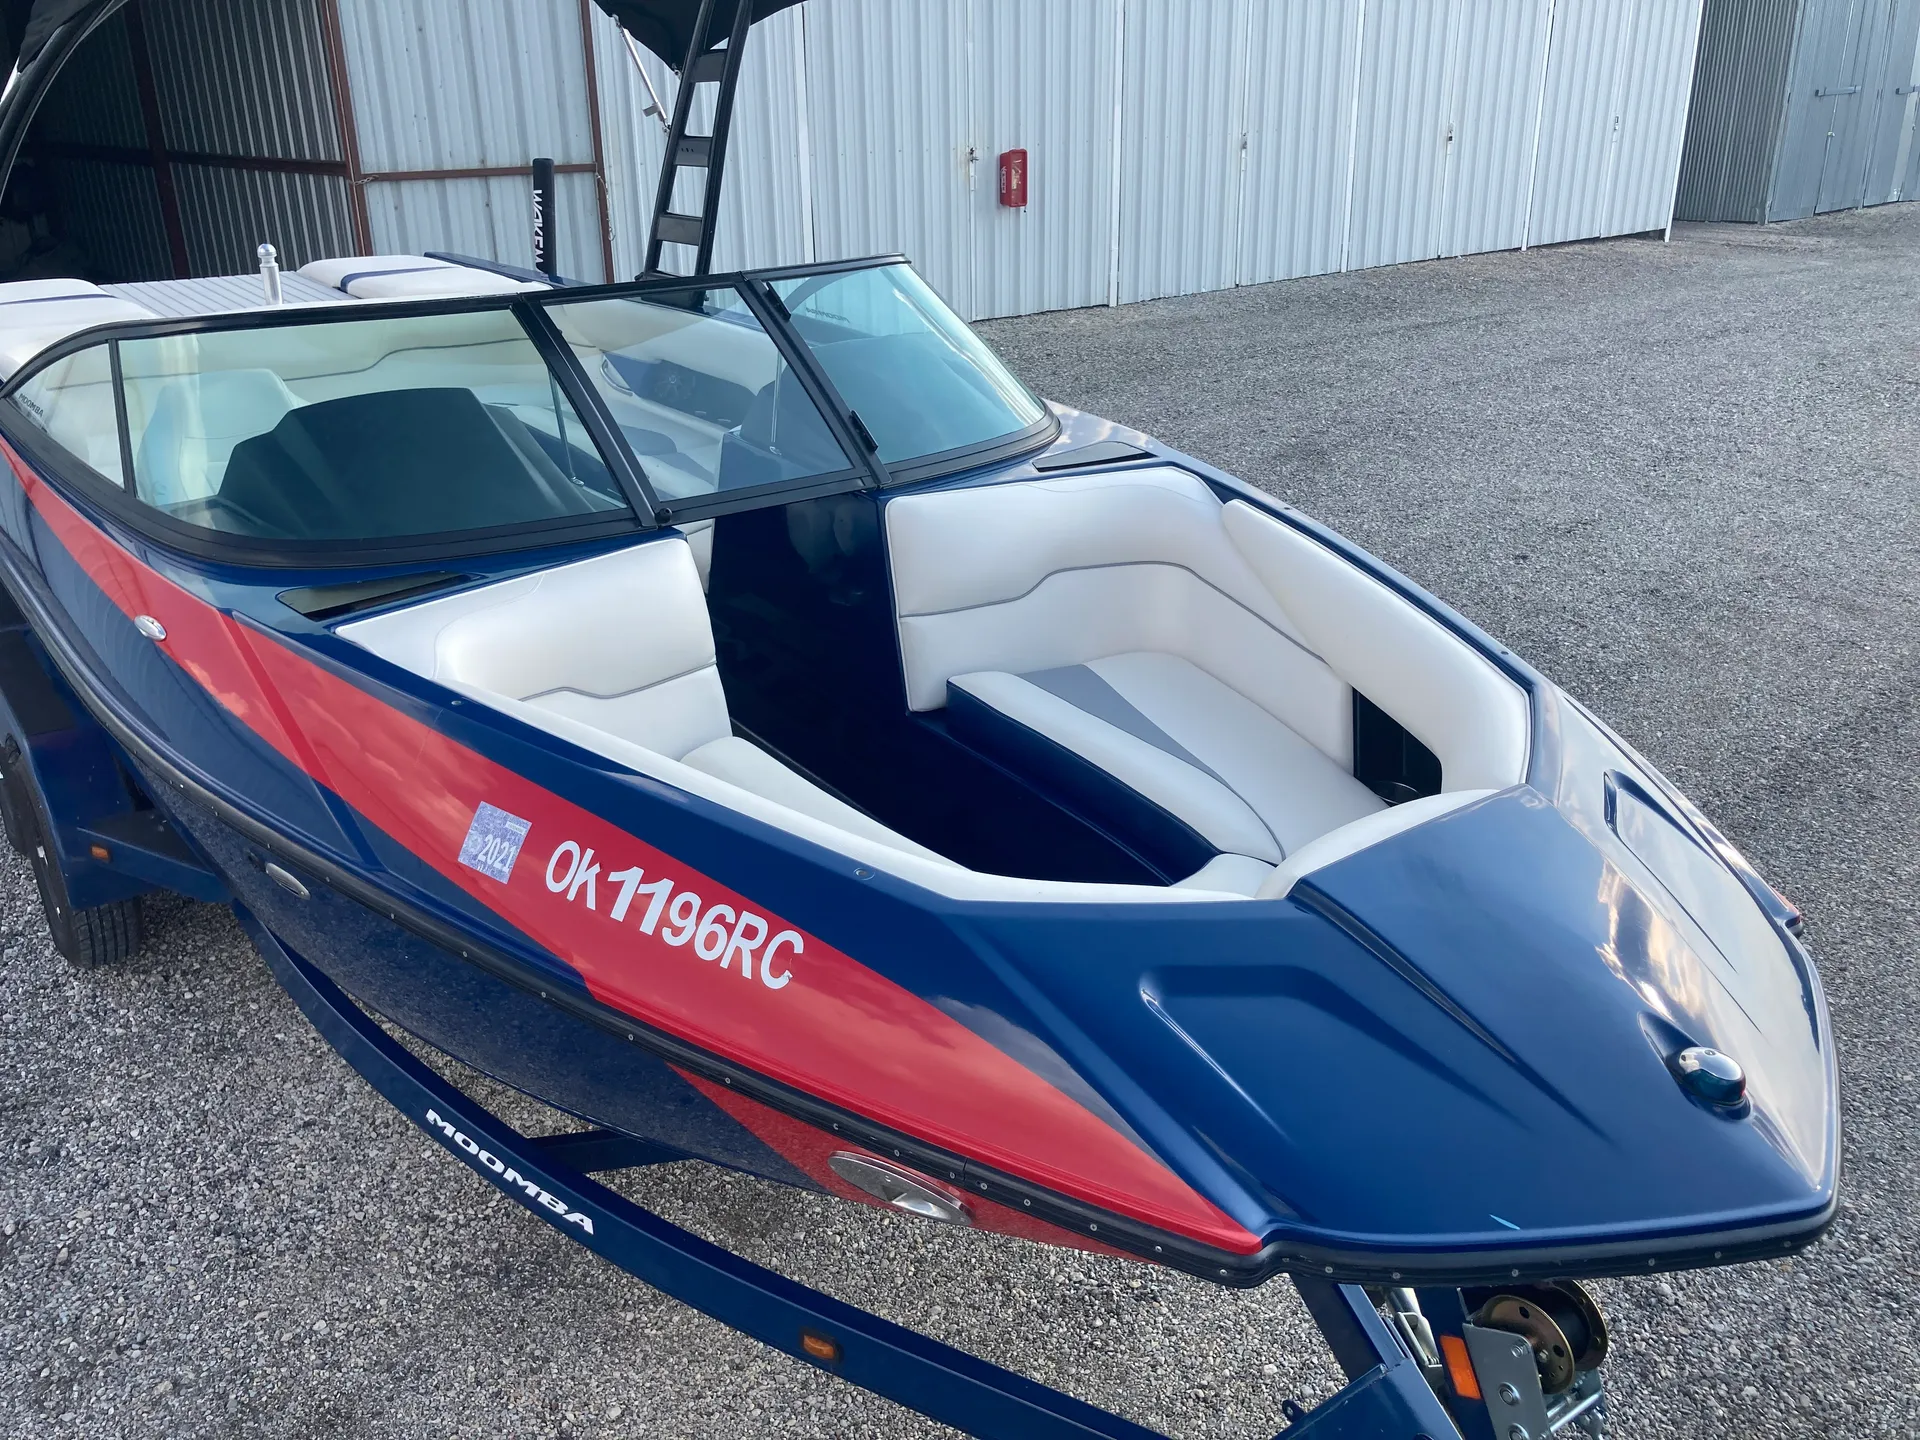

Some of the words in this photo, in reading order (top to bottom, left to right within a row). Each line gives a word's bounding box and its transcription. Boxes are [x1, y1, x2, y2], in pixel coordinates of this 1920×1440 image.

[18, 393, 44, 417] MOOMBA
[477, 834, 517, 873] 2021
[425, 1108, 595, 1235] MOOMBA
